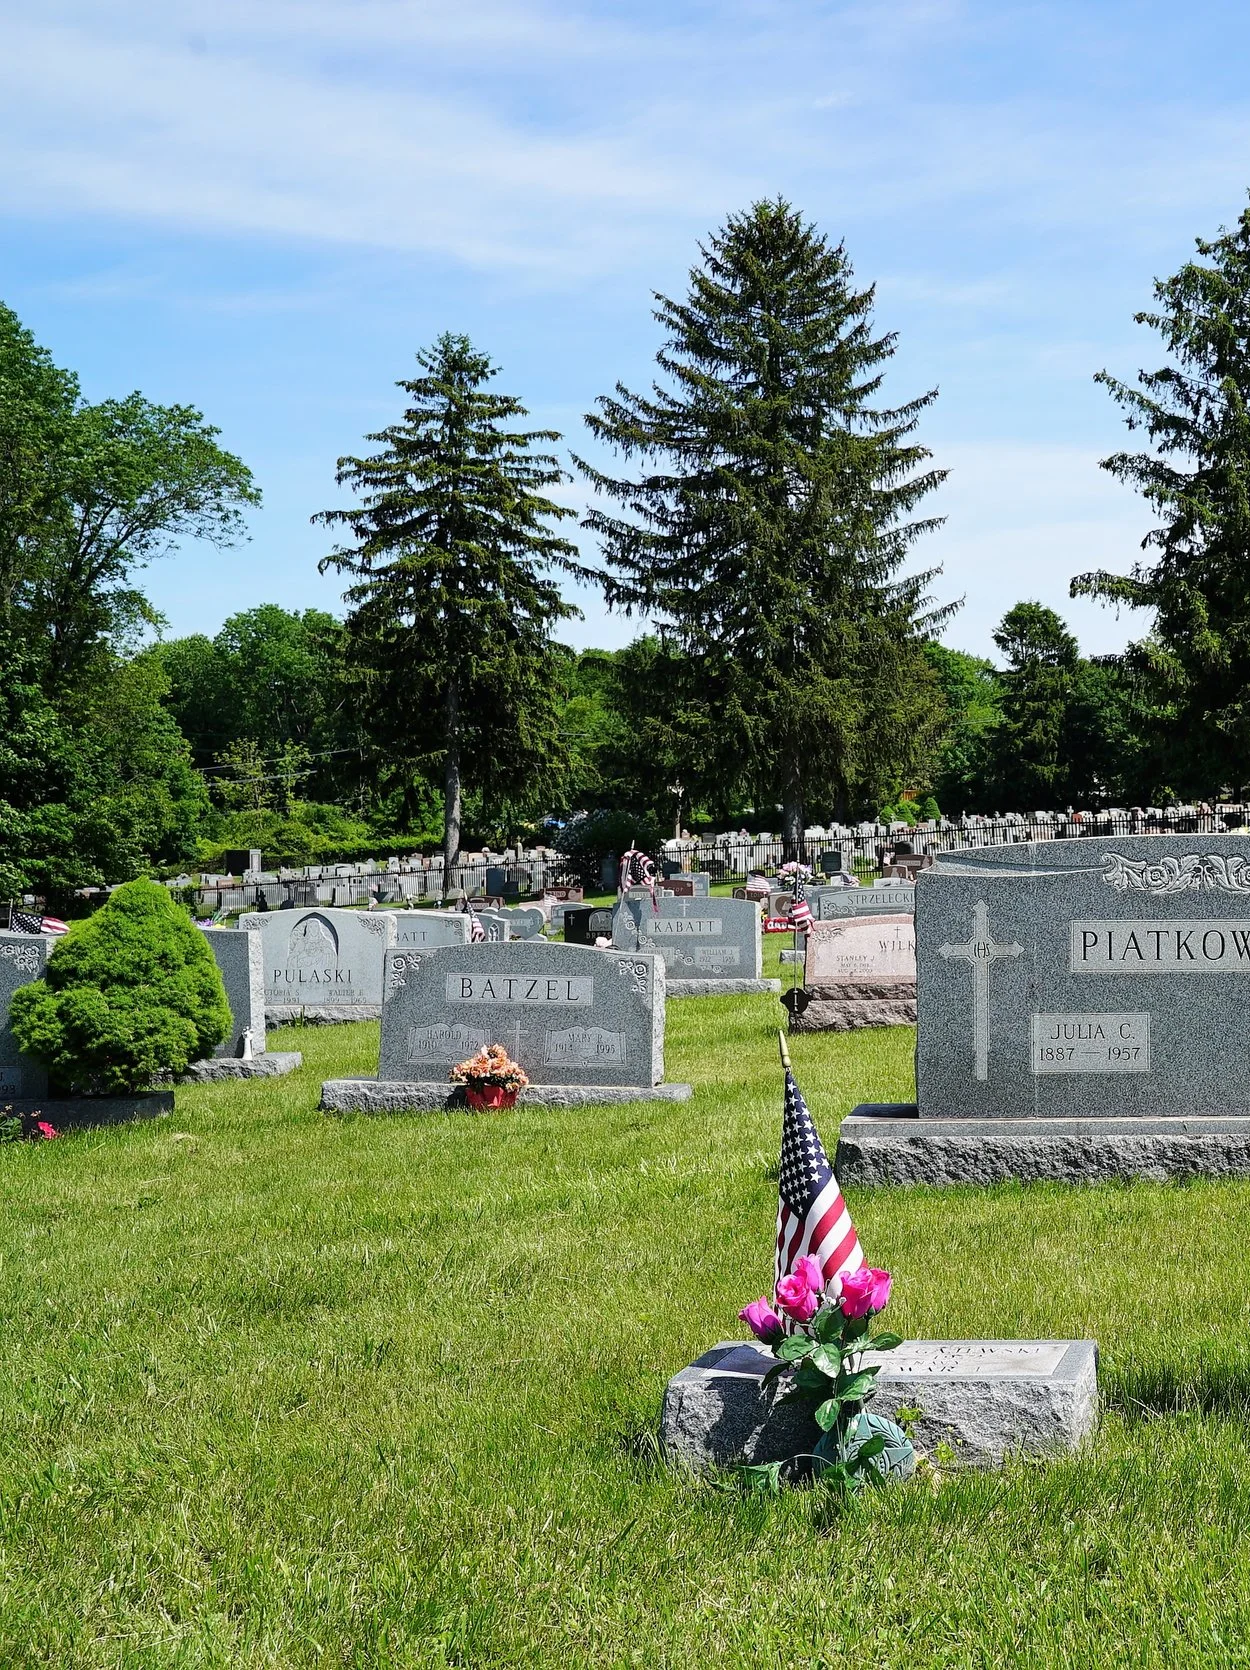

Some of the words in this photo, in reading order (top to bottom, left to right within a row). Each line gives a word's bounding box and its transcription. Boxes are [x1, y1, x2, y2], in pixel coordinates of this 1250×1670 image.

[847, 892, 913, 905] STRZELECKI
[654, 921, 715, 932] KABATT
[273, 969, 352, 983] PULASKI
[459, 977, 579, 1001] BATZEL
[427, 1030, 462, 1040] HAROLD
[568, 1033, 591, 1042] MARY
[1050, 1023, 1105, 1041] JULIA
[1039, 1046, 1075, 1061] 1887
[1106, 1046, 1141, 1061] 1957
